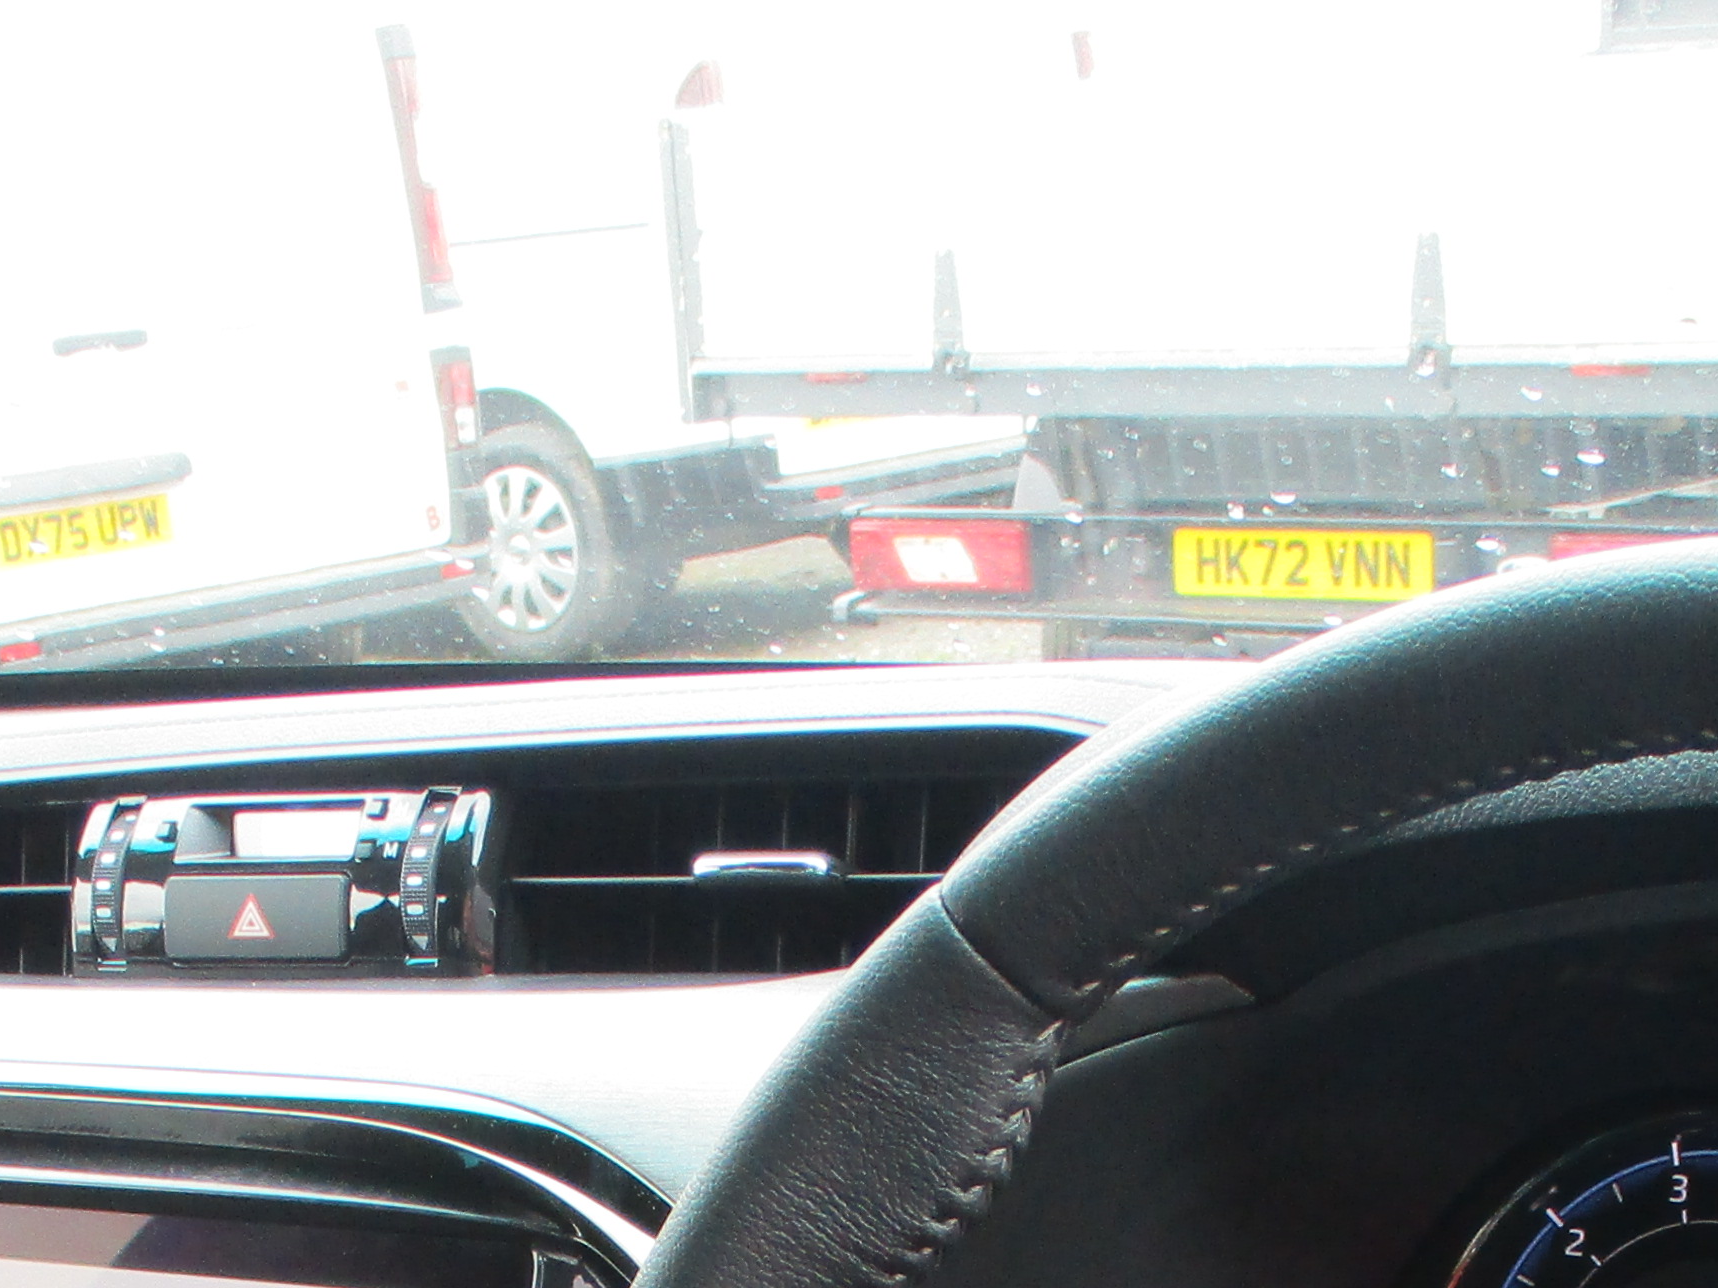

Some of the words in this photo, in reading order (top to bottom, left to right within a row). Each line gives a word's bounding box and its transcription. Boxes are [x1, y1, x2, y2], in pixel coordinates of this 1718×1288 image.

[94, 499, 161, 546] UPW
[1195, 537, 1309, 587] HK72
[1325, 539, 1411, 588] VNN
[1668, 1174, 1690, 1204] 3
[1564, 1228, 1586, 1257] 2
